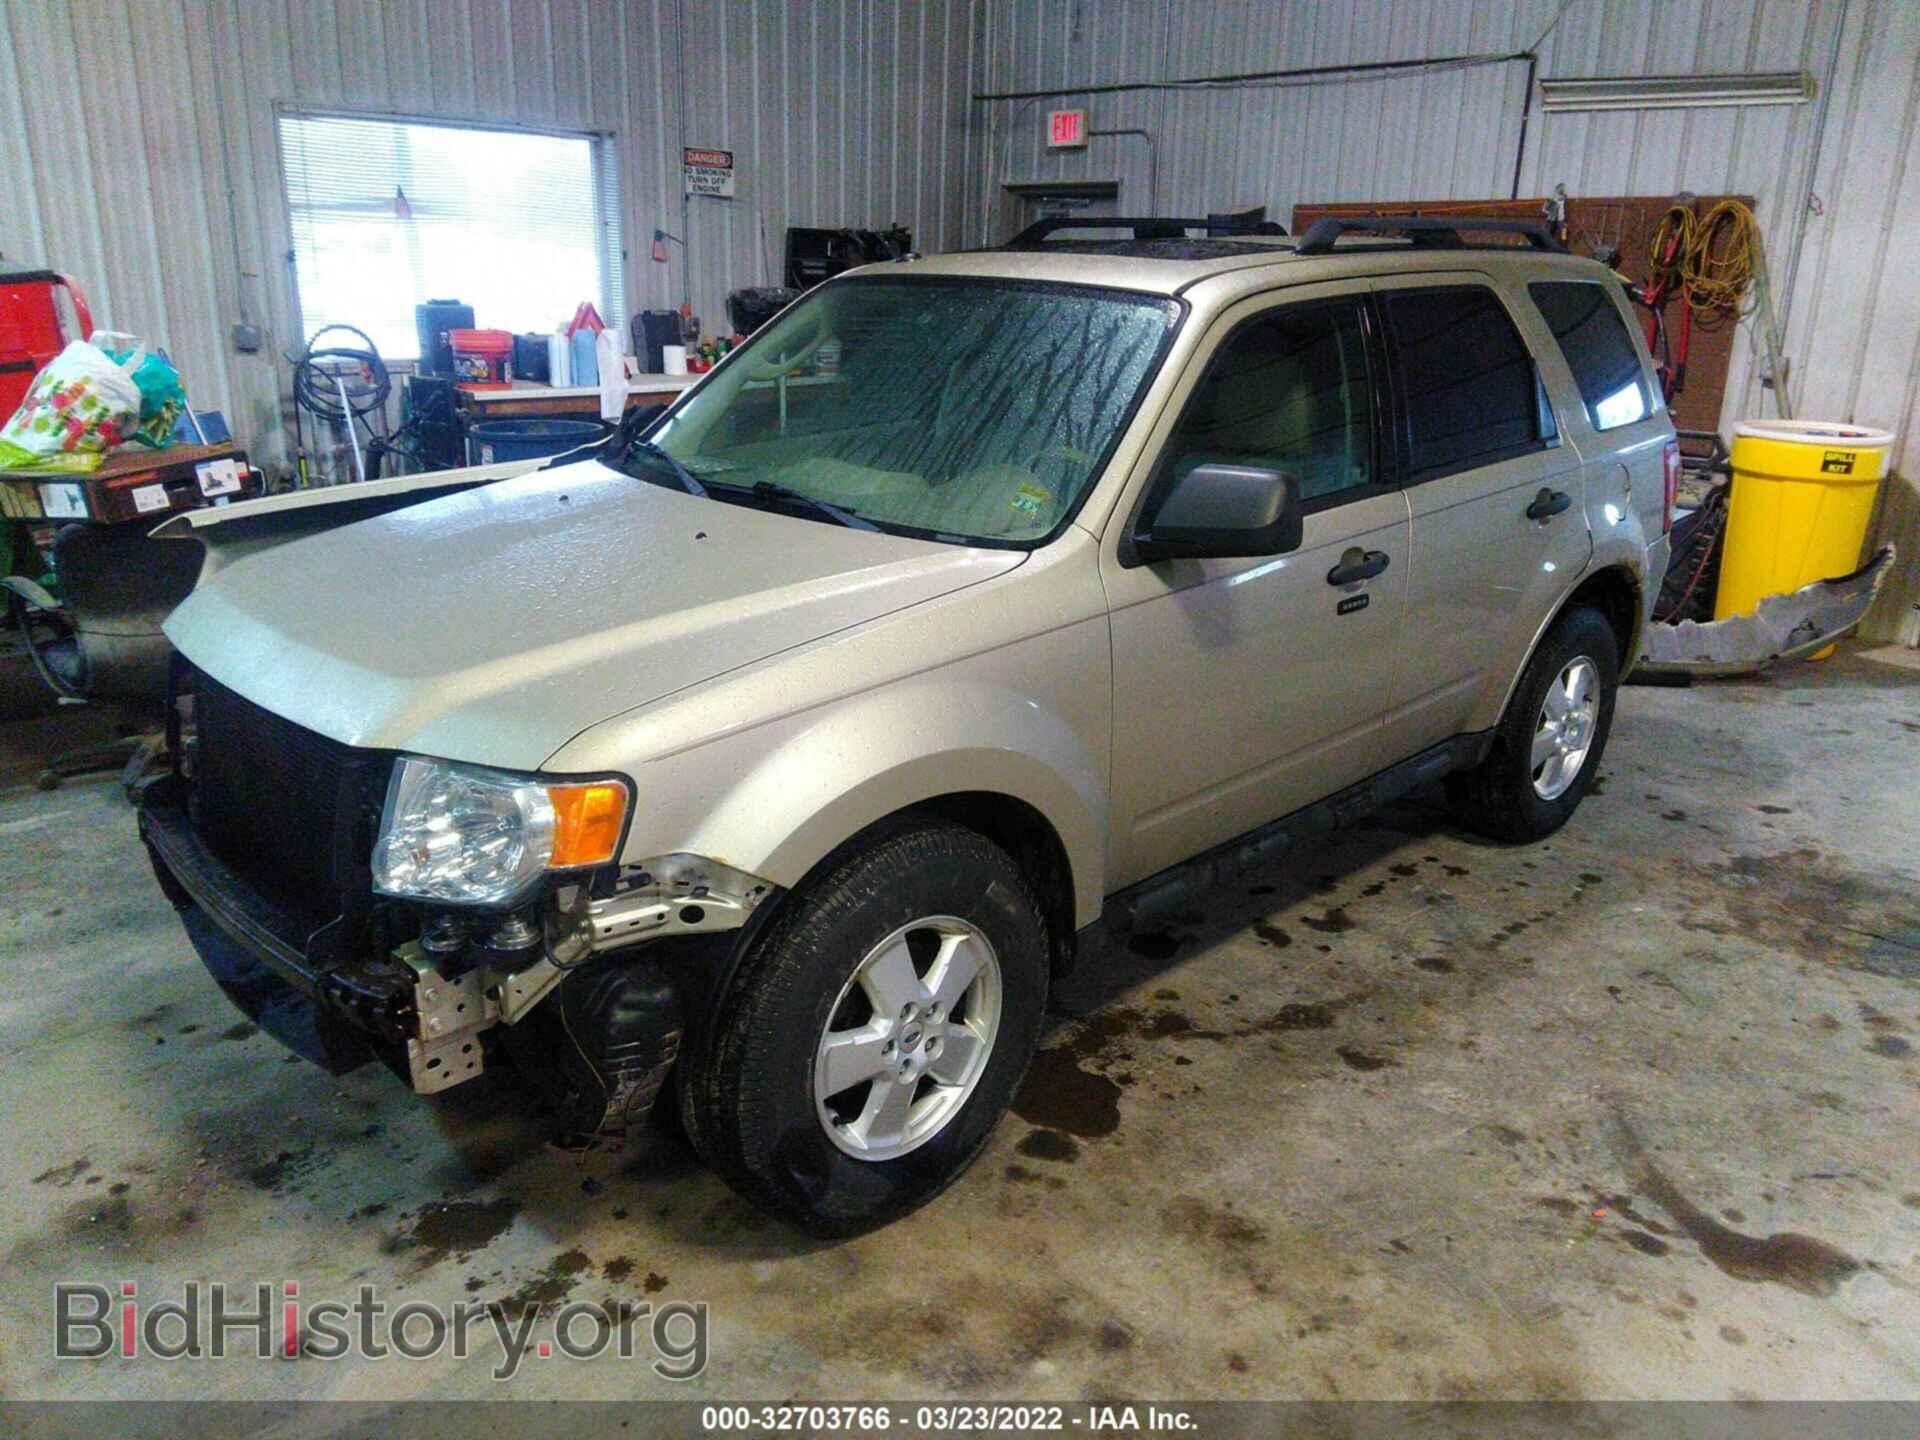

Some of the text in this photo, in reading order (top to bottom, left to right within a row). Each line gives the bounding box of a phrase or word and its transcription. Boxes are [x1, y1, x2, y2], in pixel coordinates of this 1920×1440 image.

[1052, 112, 1081, 143] EXIT
[687, 152, 729, 164] DANGER
[696, 167, 732, 177] SMOKING
[688, 175, 728, 185] TURN OFF
[692, 185, 721, 193] ENGINE
[1825, 452, 1855, 463] SPILL
[1828, 463, 1848, 473] KIT
